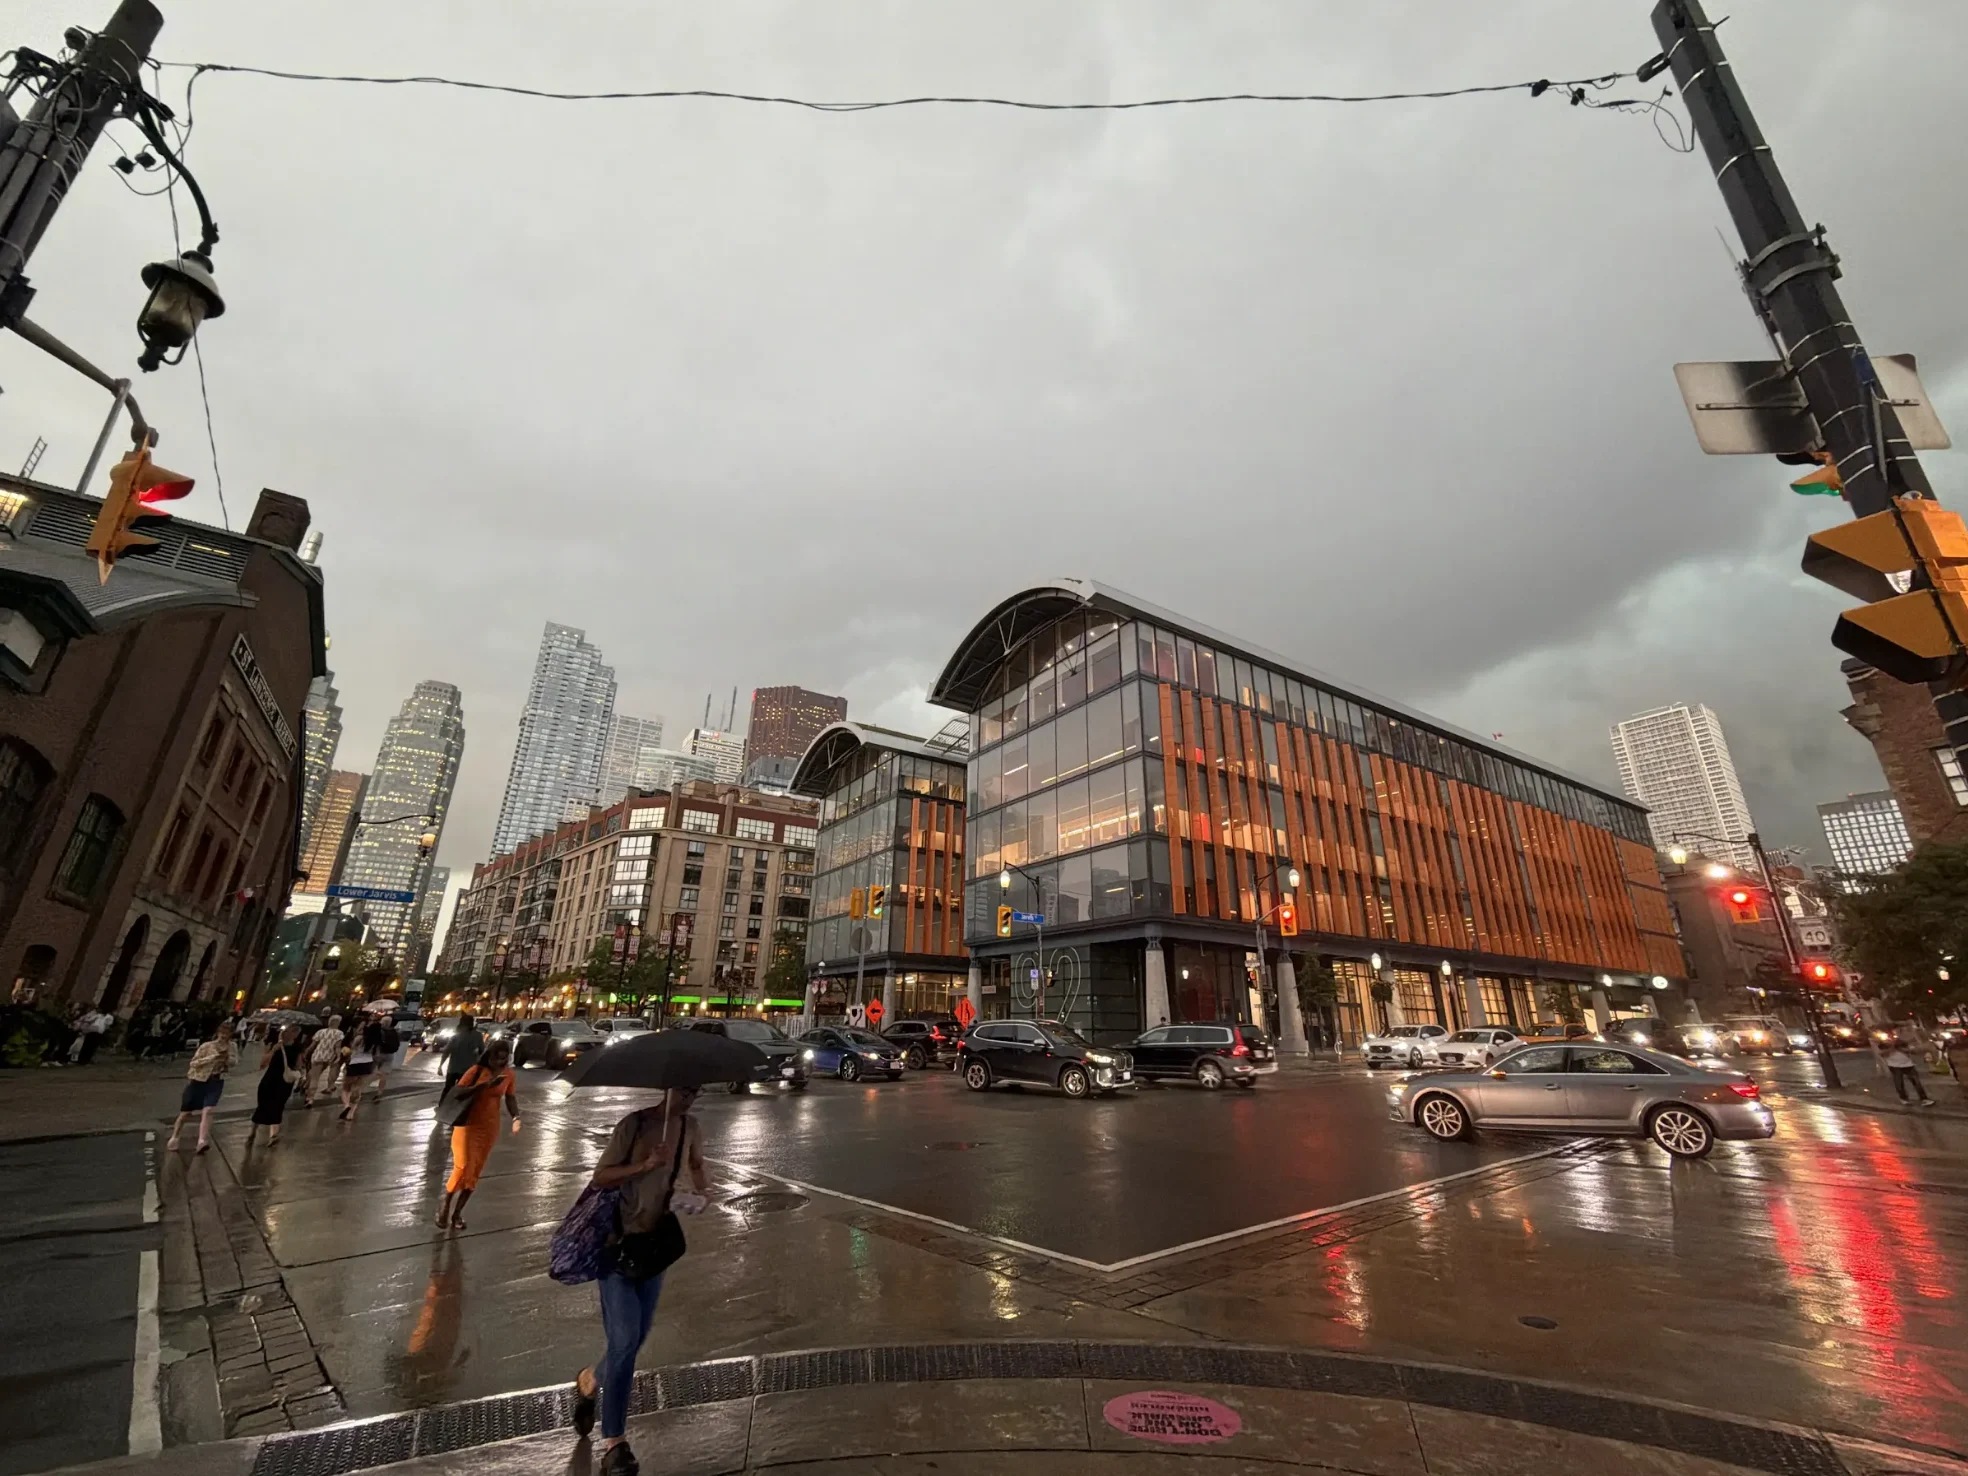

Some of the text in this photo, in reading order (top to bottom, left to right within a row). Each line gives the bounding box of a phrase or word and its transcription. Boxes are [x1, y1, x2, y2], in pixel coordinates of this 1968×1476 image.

[337, 886, 368, 898] Lower
[368, 888, 397, 900] Jarvis
[1805, 931, 1825, 942] 40
